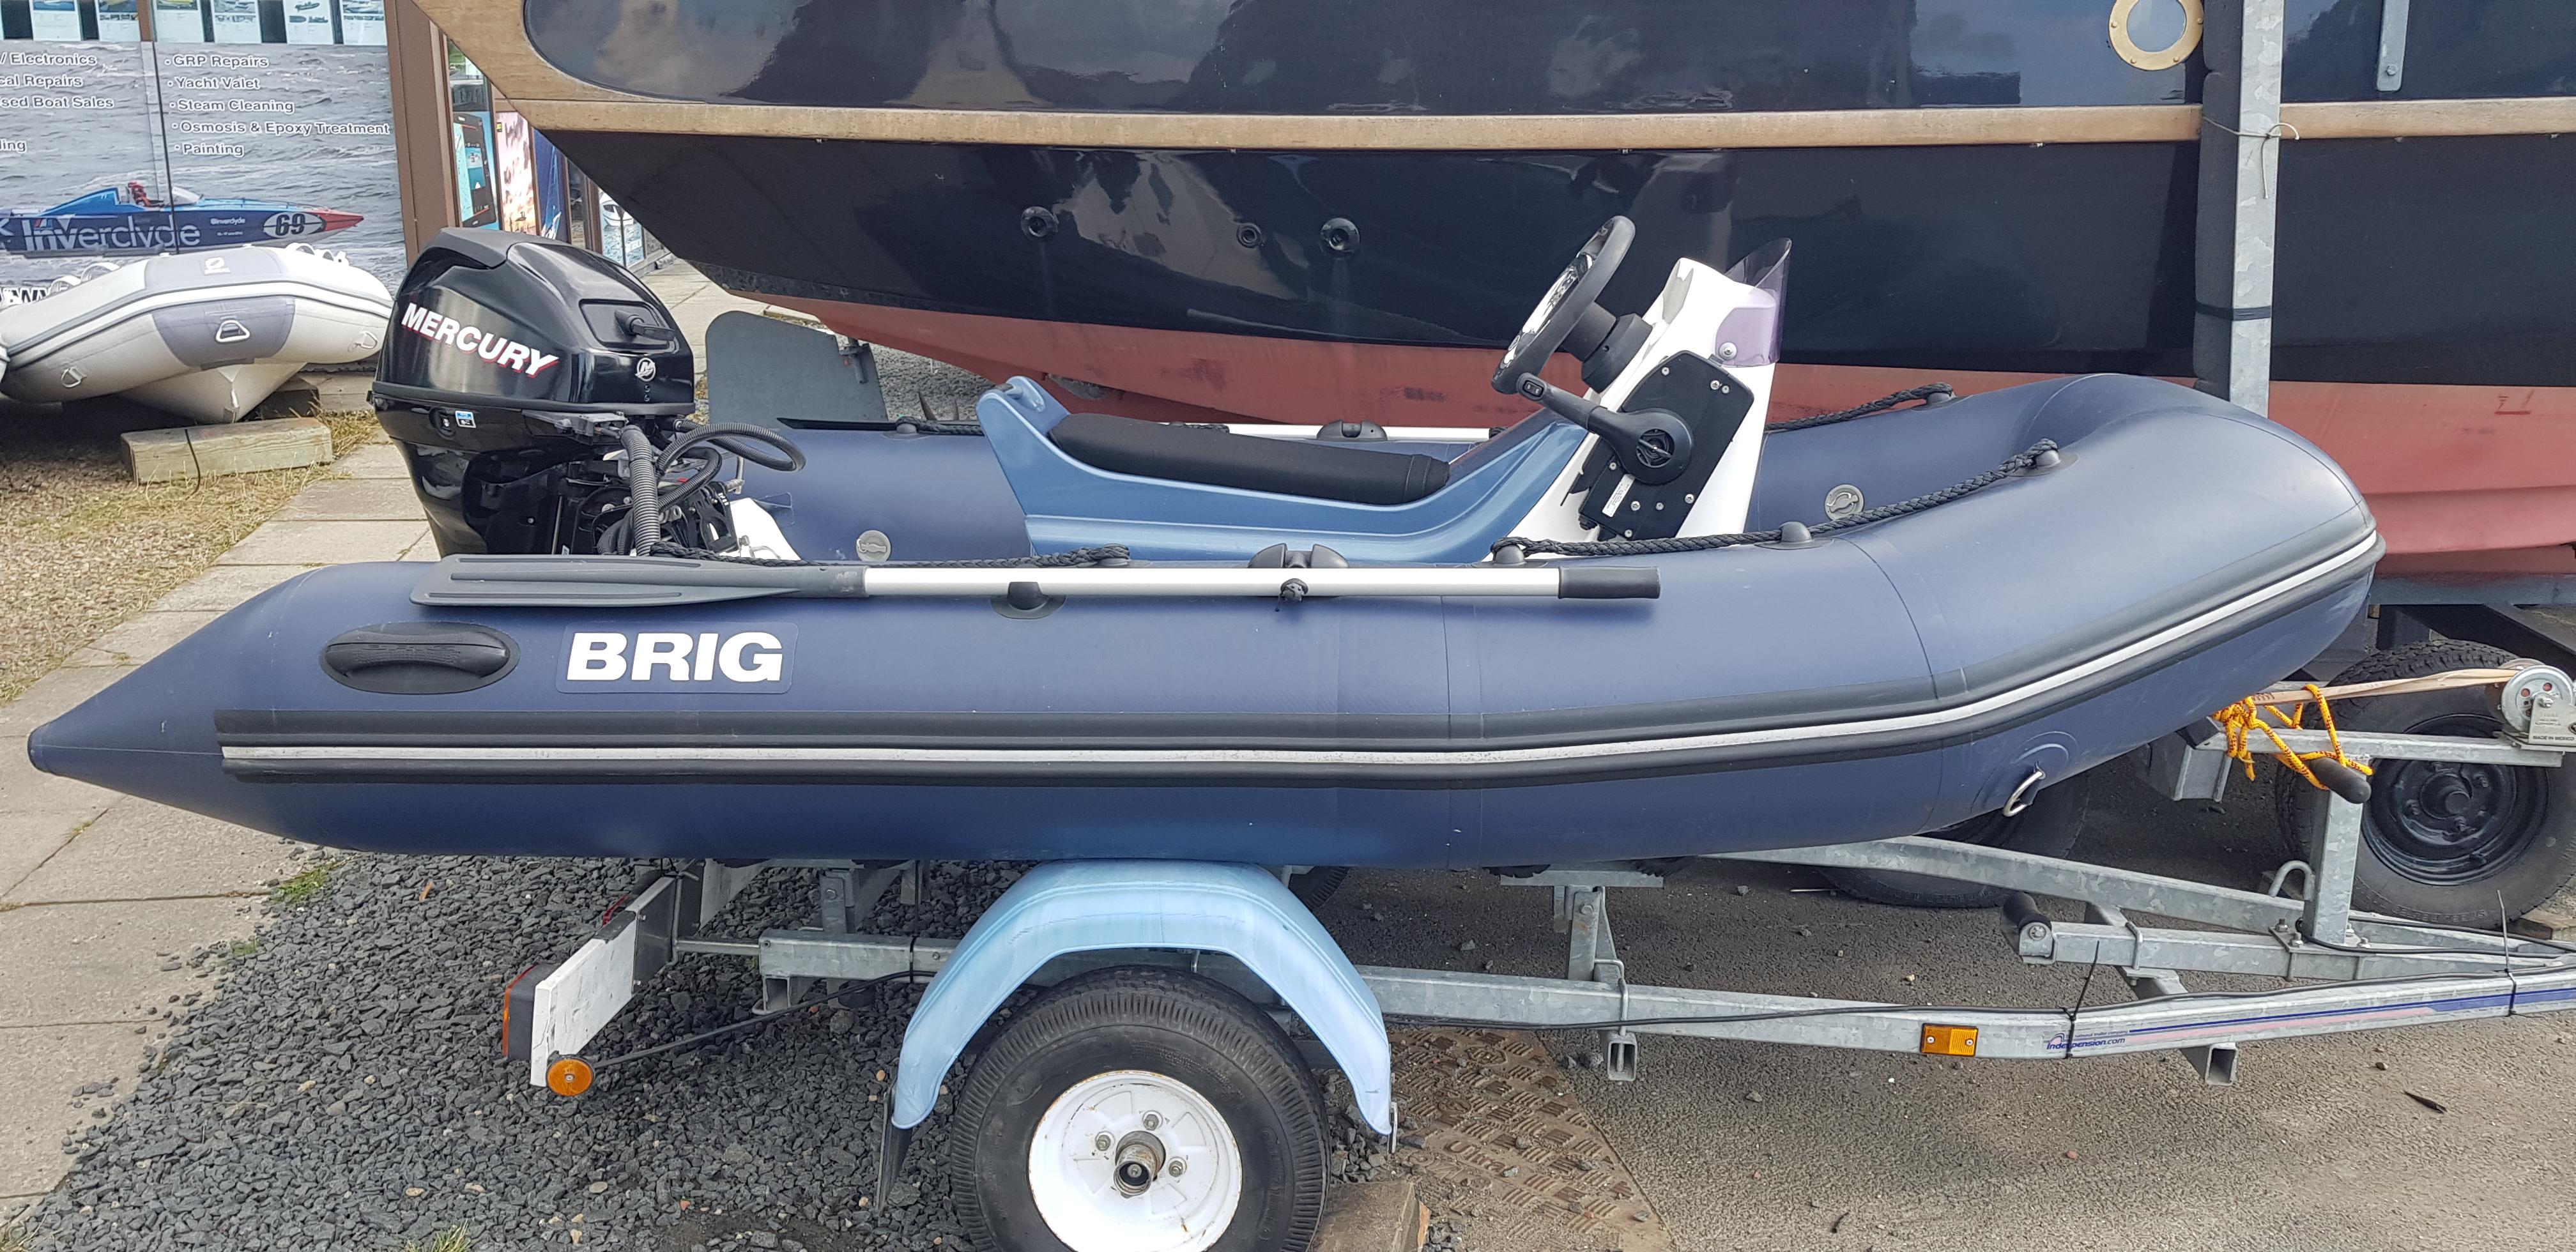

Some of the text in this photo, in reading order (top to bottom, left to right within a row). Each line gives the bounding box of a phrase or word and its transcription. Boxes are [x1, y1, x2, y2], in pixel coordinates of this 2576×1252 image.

[11, 54, 96, 65] Electronics
[174, 56, 268, 68] GRP Repairs
[25, 75, 82, 88] Repairs
[176, 78, 259, 88] Yacht Valet
[34, 97, 68, 107] Boat
[73, 97, 114, 107] Sales
[178, 100, 293, 112] Steam Cleaning
[181, 122, 390, 135] Osmosis & Epoxy Treatment
[183, 144, 243, 156] Painting
[275, 213, 305, 236] 69
[21, 214, 201, 250] Inverclyde
[401, 302, 560, 379] MERCURY
[567, 632, 783, 682] BRIG
